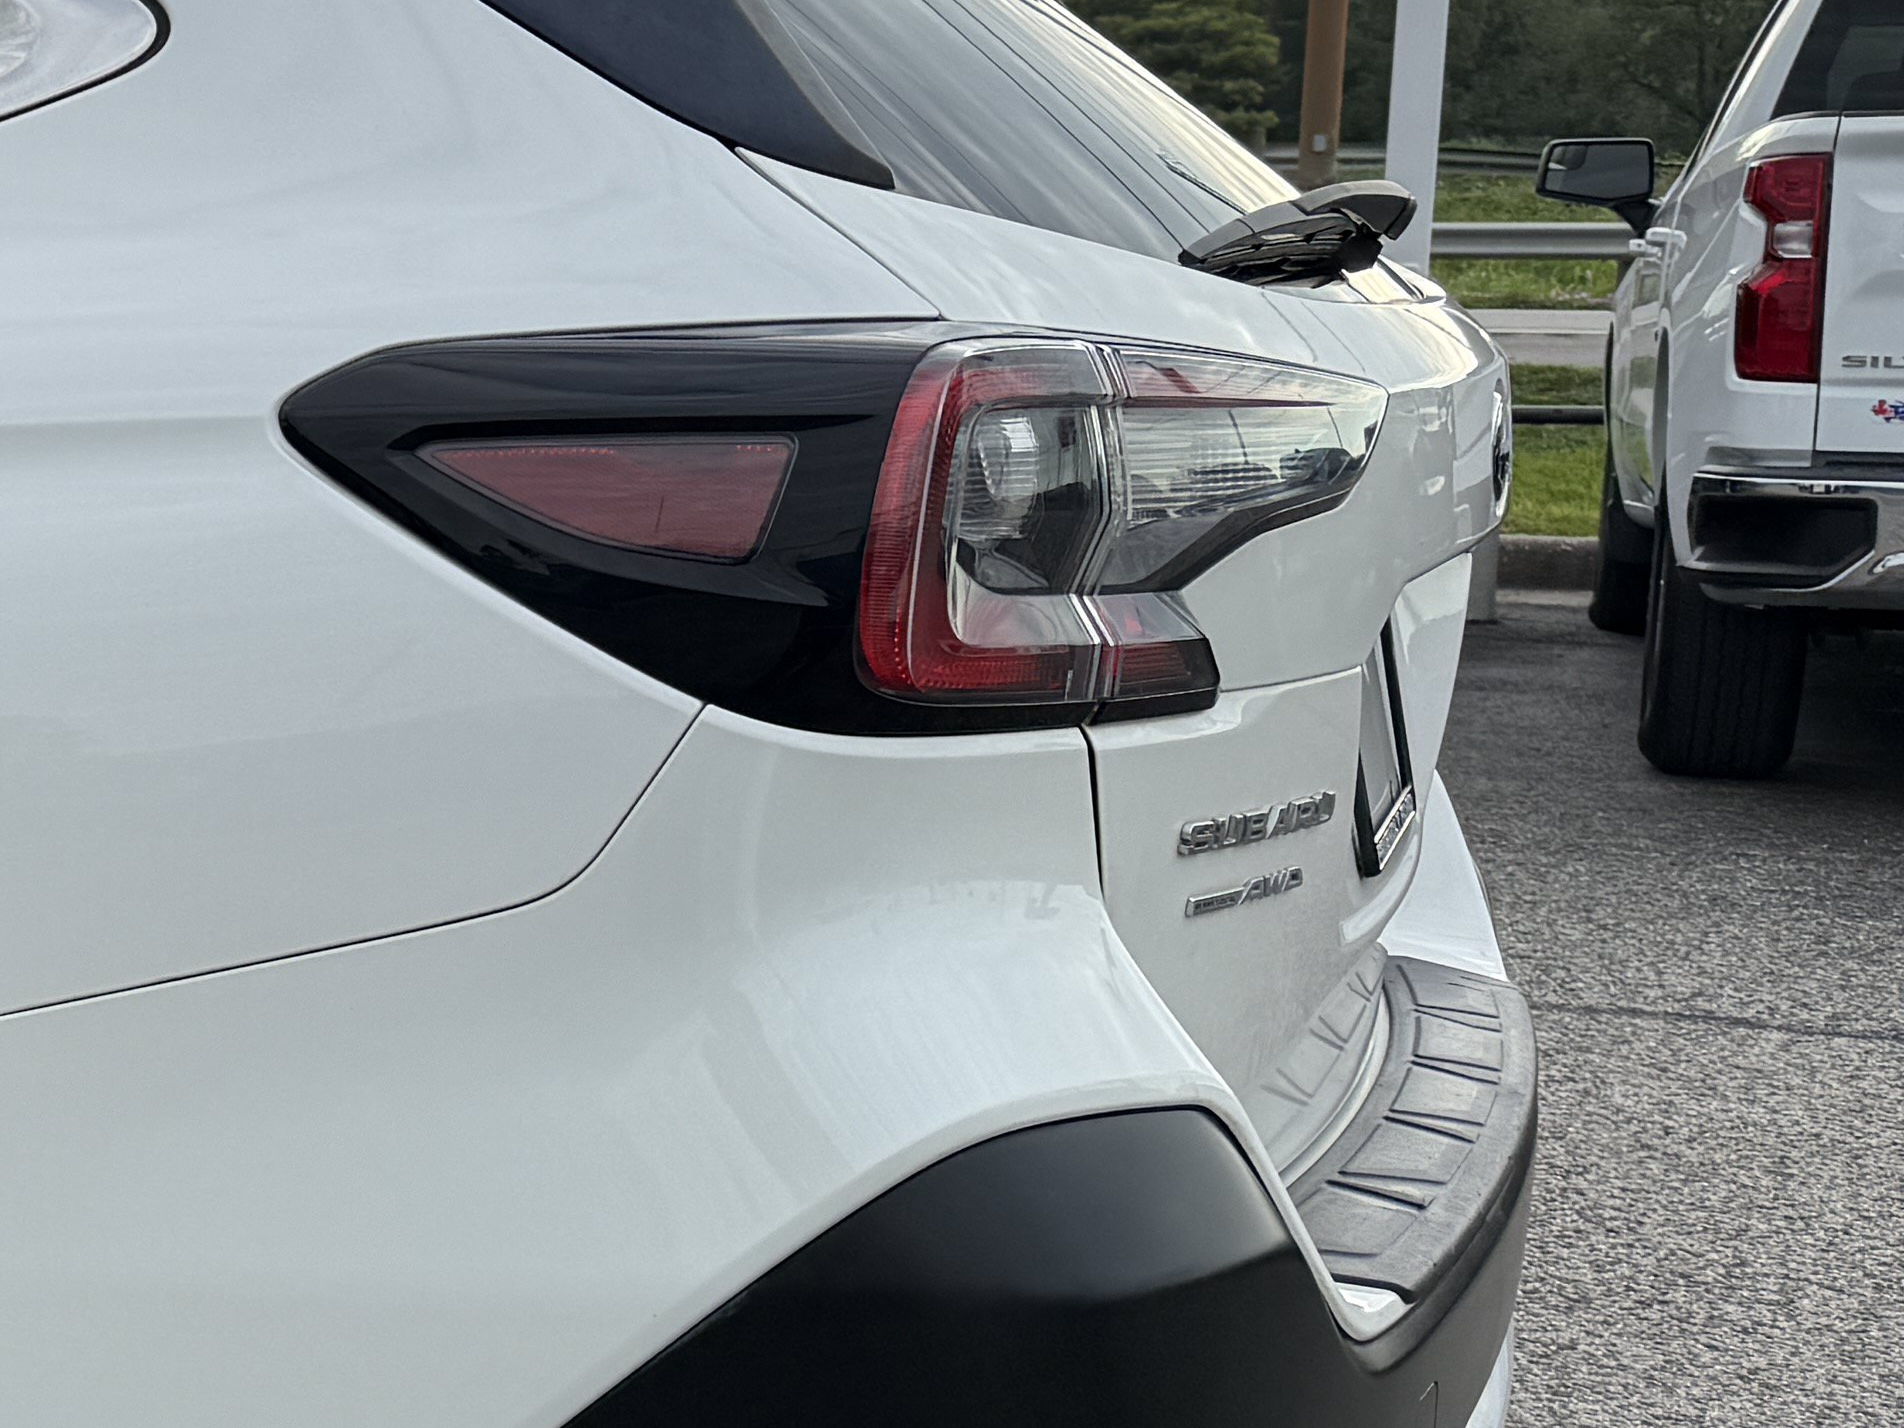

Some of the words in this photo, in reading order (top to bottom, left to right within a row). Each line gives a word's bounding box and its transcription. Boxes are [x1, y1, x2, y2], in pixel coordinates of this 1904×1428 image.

[1841, 355, 1904, 369] SIL
[1177, 790, 1336, 857] SUBARU
[1238, 867, 1304, 905] AWD
